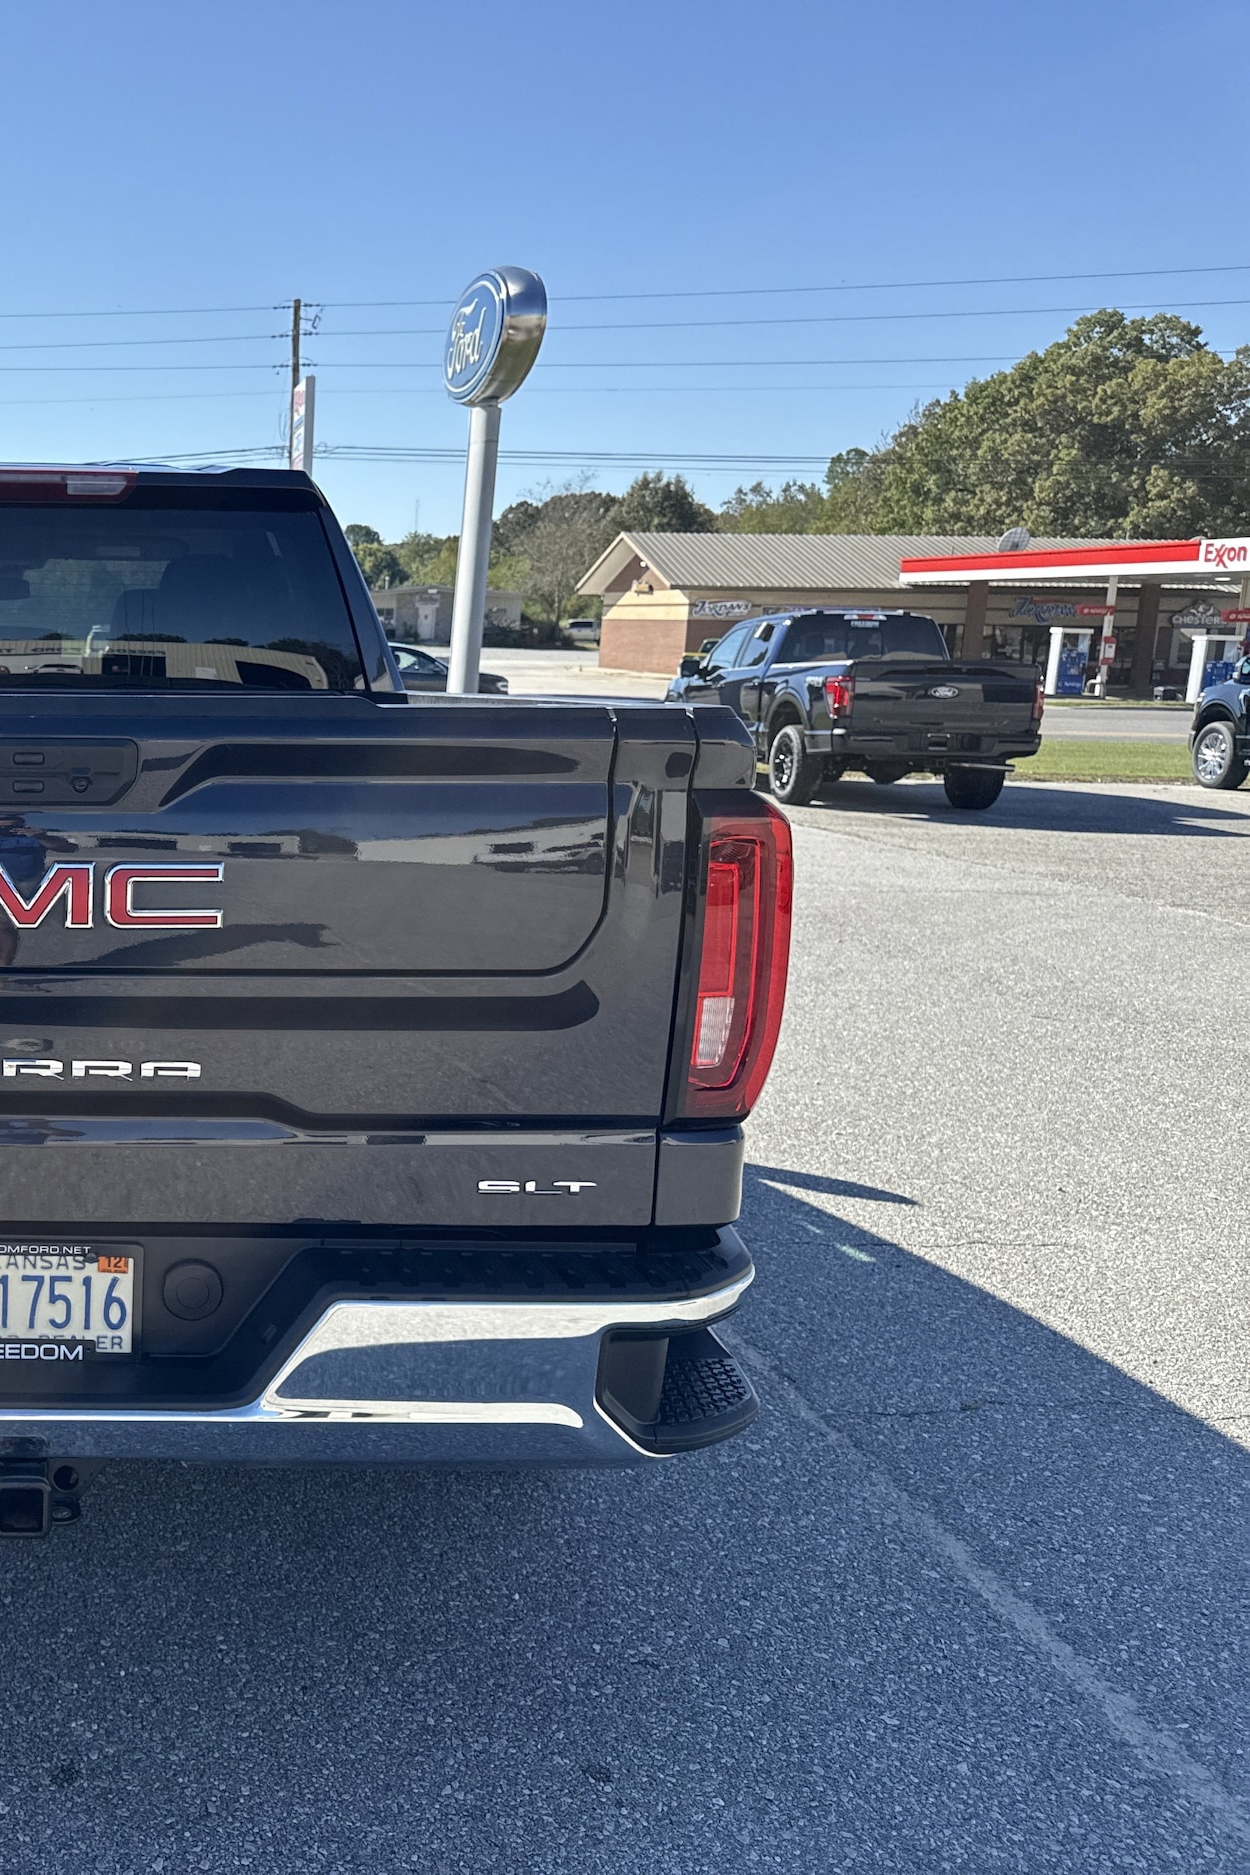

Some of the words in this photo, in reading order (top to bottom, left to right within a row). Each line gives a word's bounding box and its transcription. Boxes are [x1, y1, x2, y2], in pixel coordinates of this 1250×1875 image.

[447, 298, 487, 380] Ford
[1204, 543, 1248, 569] Exxon
[477, 1180, 598, 1194] SLT
[107, 1256, 122, 1269] 12
